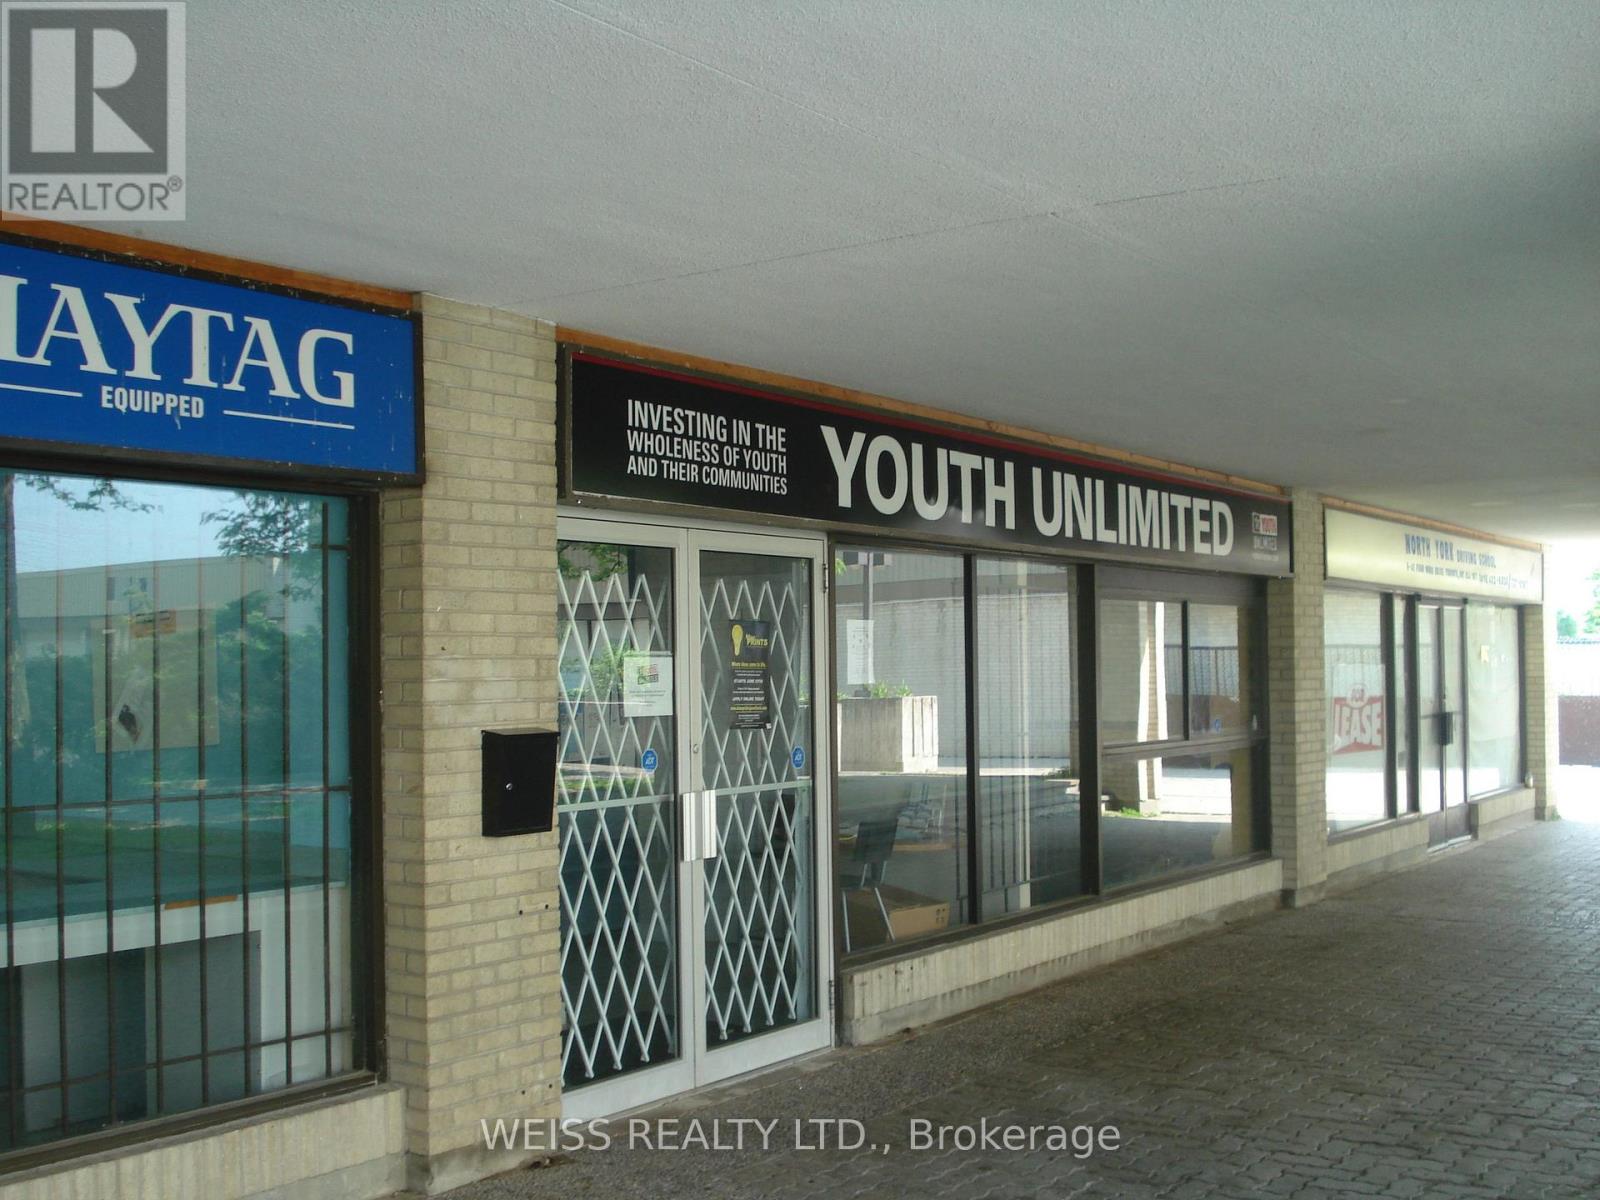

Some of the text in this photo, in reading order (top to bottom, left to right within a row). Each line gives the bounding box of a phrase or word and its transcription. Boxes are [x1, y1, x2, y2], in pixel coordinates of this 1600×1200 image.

[101, 385, 205, 419] EQUIPPED
[627, 399, 787, 453] INVESTING IN THE
[627, 429, 787, 475] WHOLENESS OF YOUTH
[627, 455, 788, 496] AND THEIR COMMUNITIES
[820, 425, 1235, 557] YOUTH UNLIMITED
[1404, 534, 1431, 559] NORTH
[1333, 700, 1384, 750] LEASE
